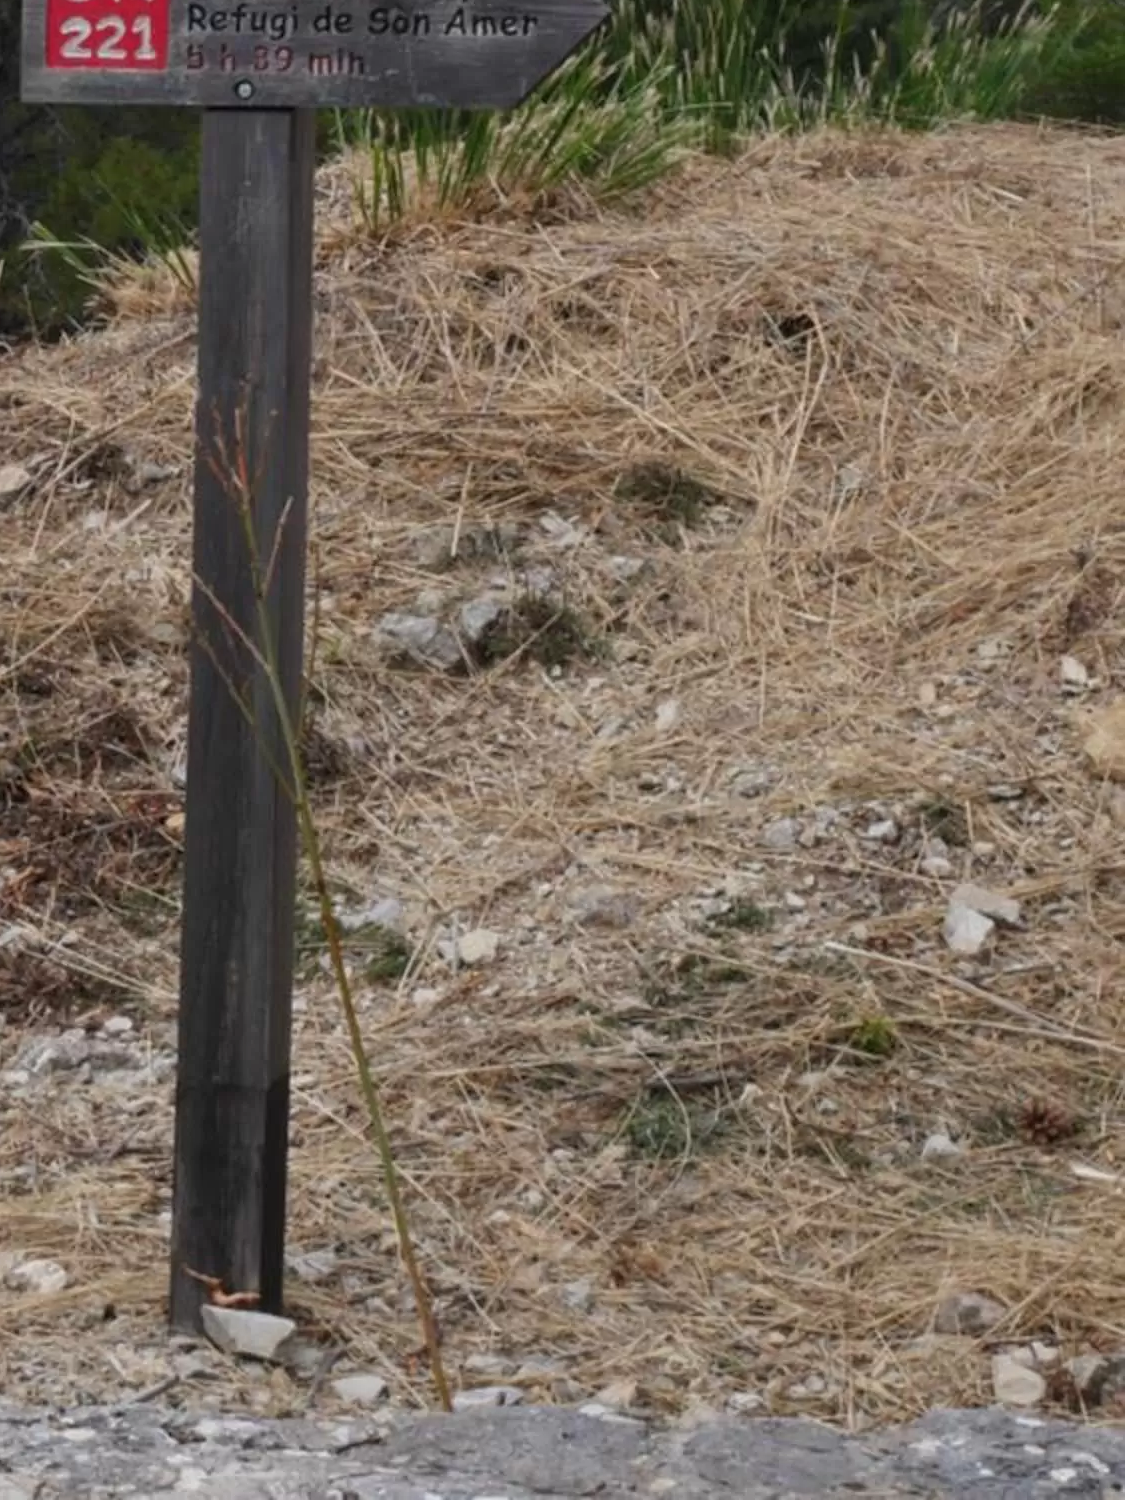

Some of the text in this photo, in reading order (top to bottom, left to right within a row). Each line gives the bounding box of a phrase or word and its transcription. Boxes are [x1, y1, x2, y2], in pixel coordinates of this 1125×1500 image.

[59, 14, 157, 61] 221
[187, 3, 298, 41] Refugi
[313, 5, 355, 34] de
[444, 5, 539, 37] Amer
[220, 45, 237, 73] h
[308, 47, 365, 77] min
